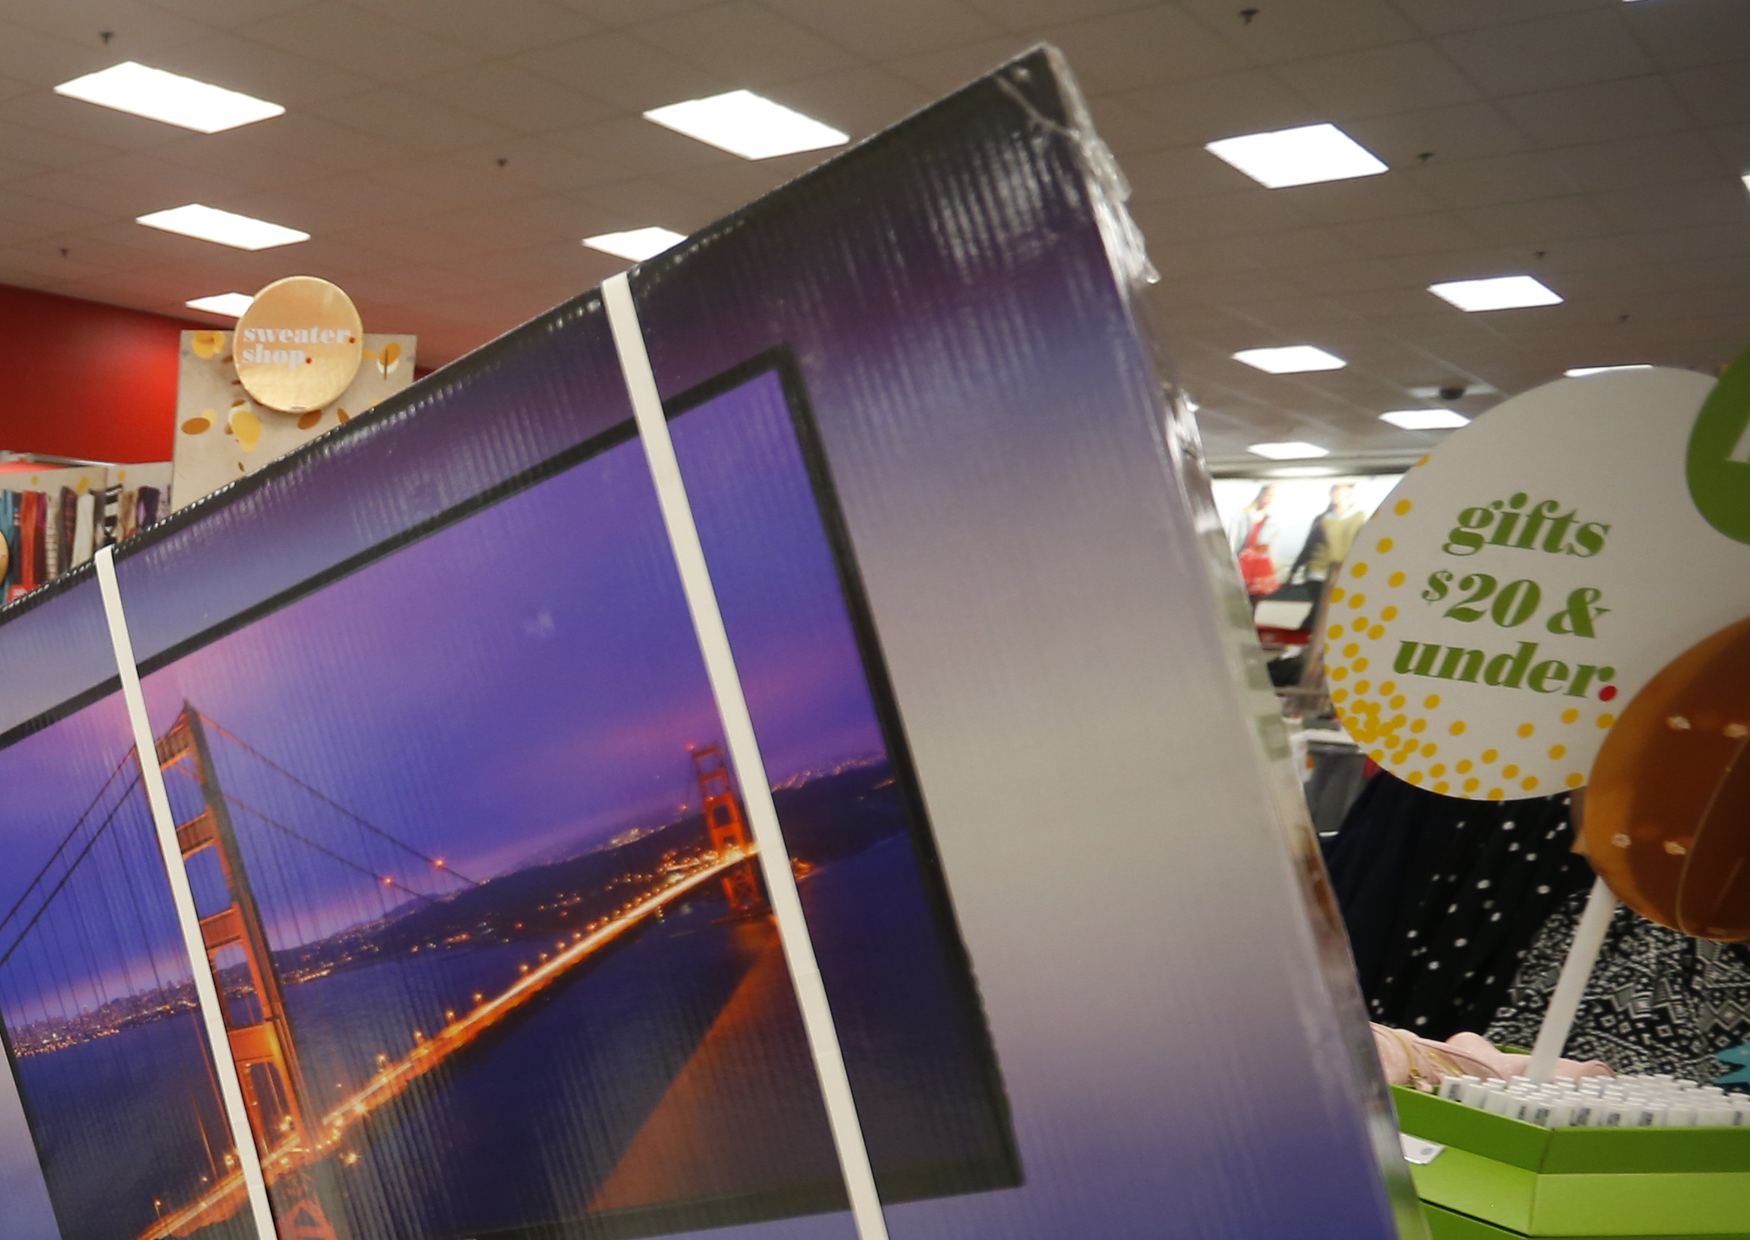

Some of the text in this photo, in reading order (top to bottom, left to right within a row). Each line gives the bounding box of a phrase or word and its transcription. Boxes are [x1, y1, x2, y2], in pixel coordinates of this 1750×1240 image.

[1441, 491, 1612, 558] gifts
[1422, 567, 1613, 639] $20 &
